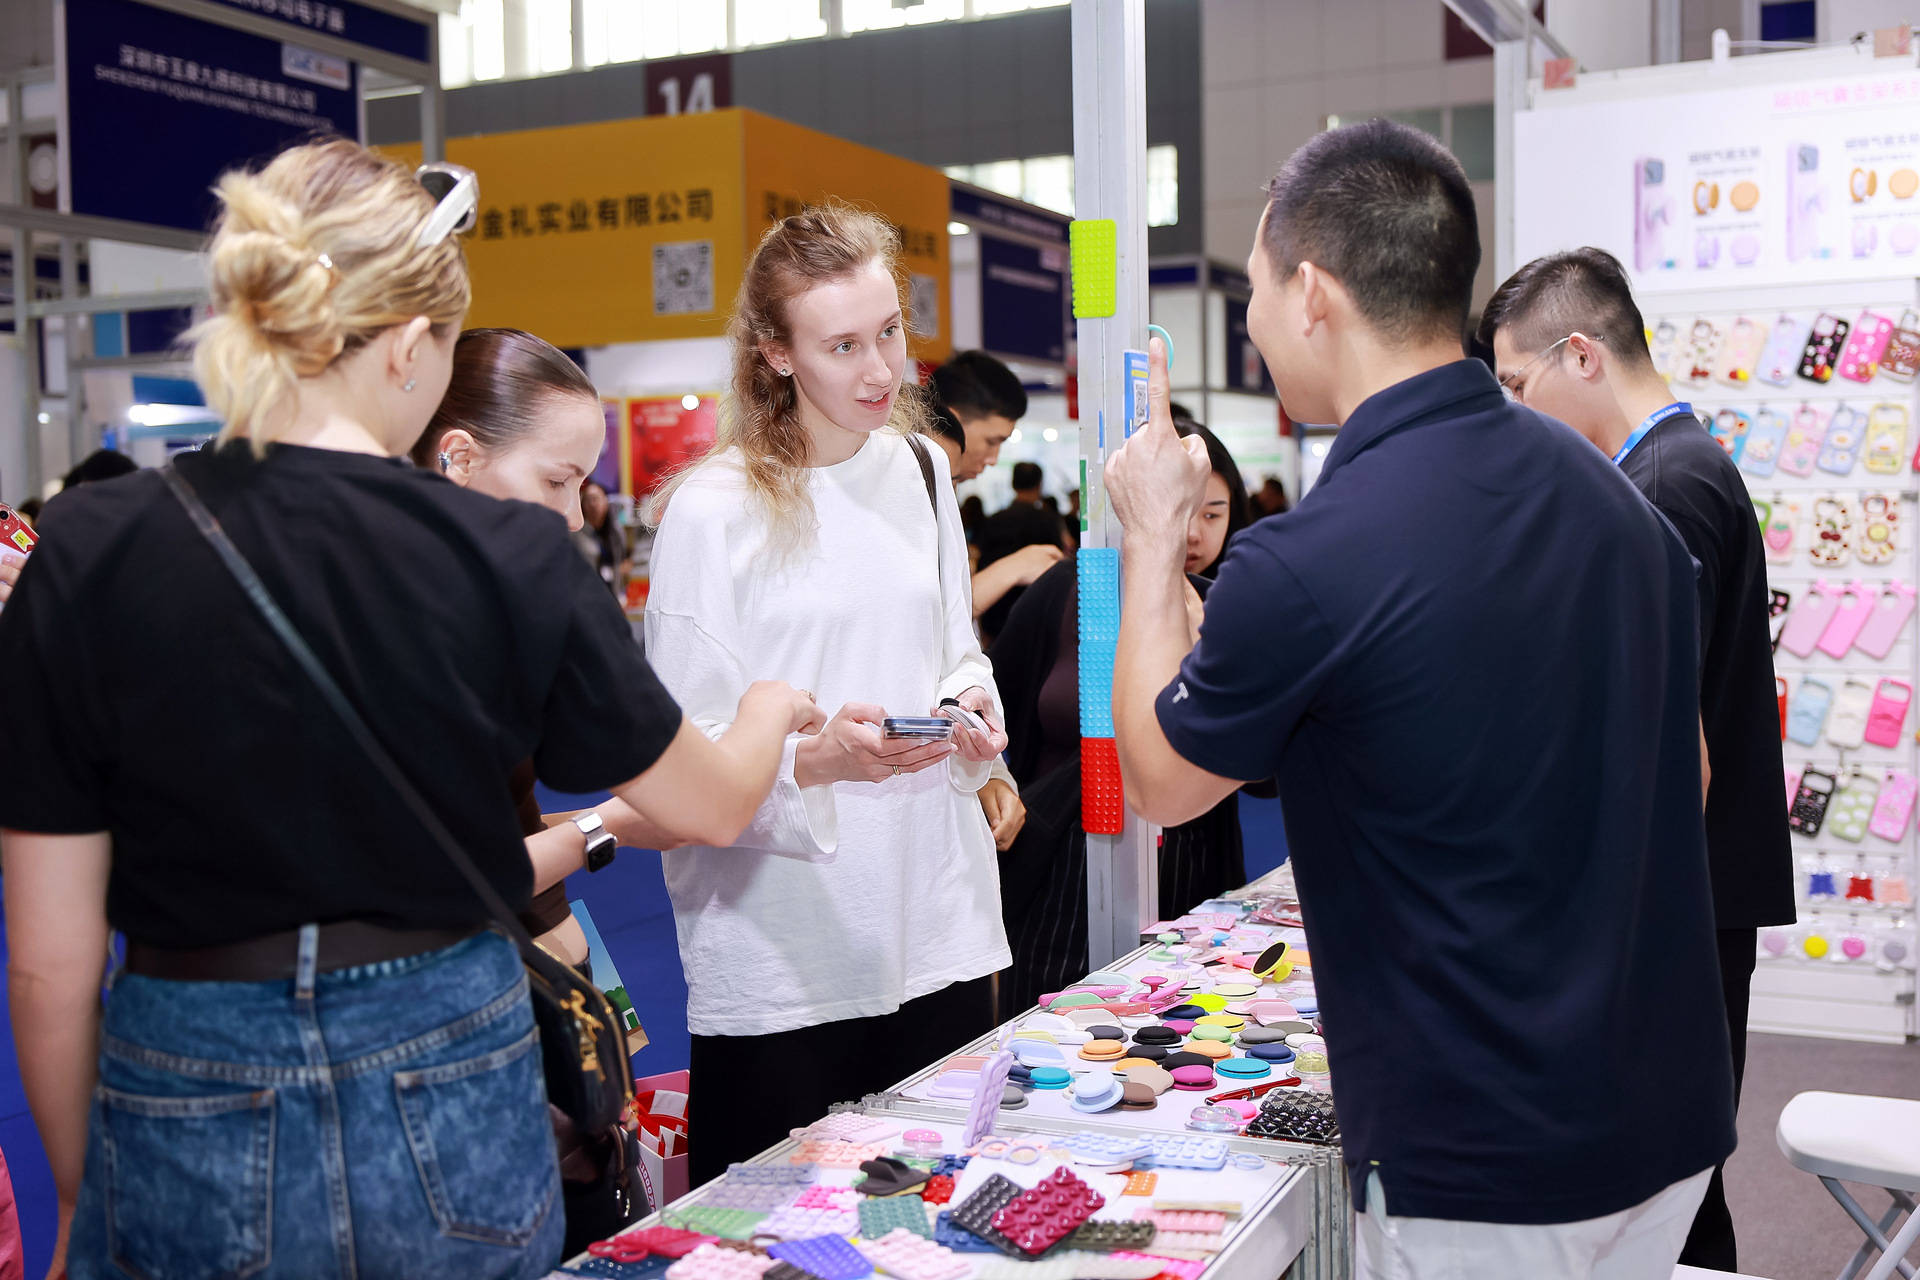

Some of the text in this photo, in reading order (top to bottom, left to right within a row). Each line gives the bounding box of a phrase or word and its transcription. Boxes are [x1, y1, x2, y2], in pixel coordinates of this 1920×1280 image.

[658, 73, 715, 115] 14
[462, 187, 714, 241] 金礼实业有限公司
